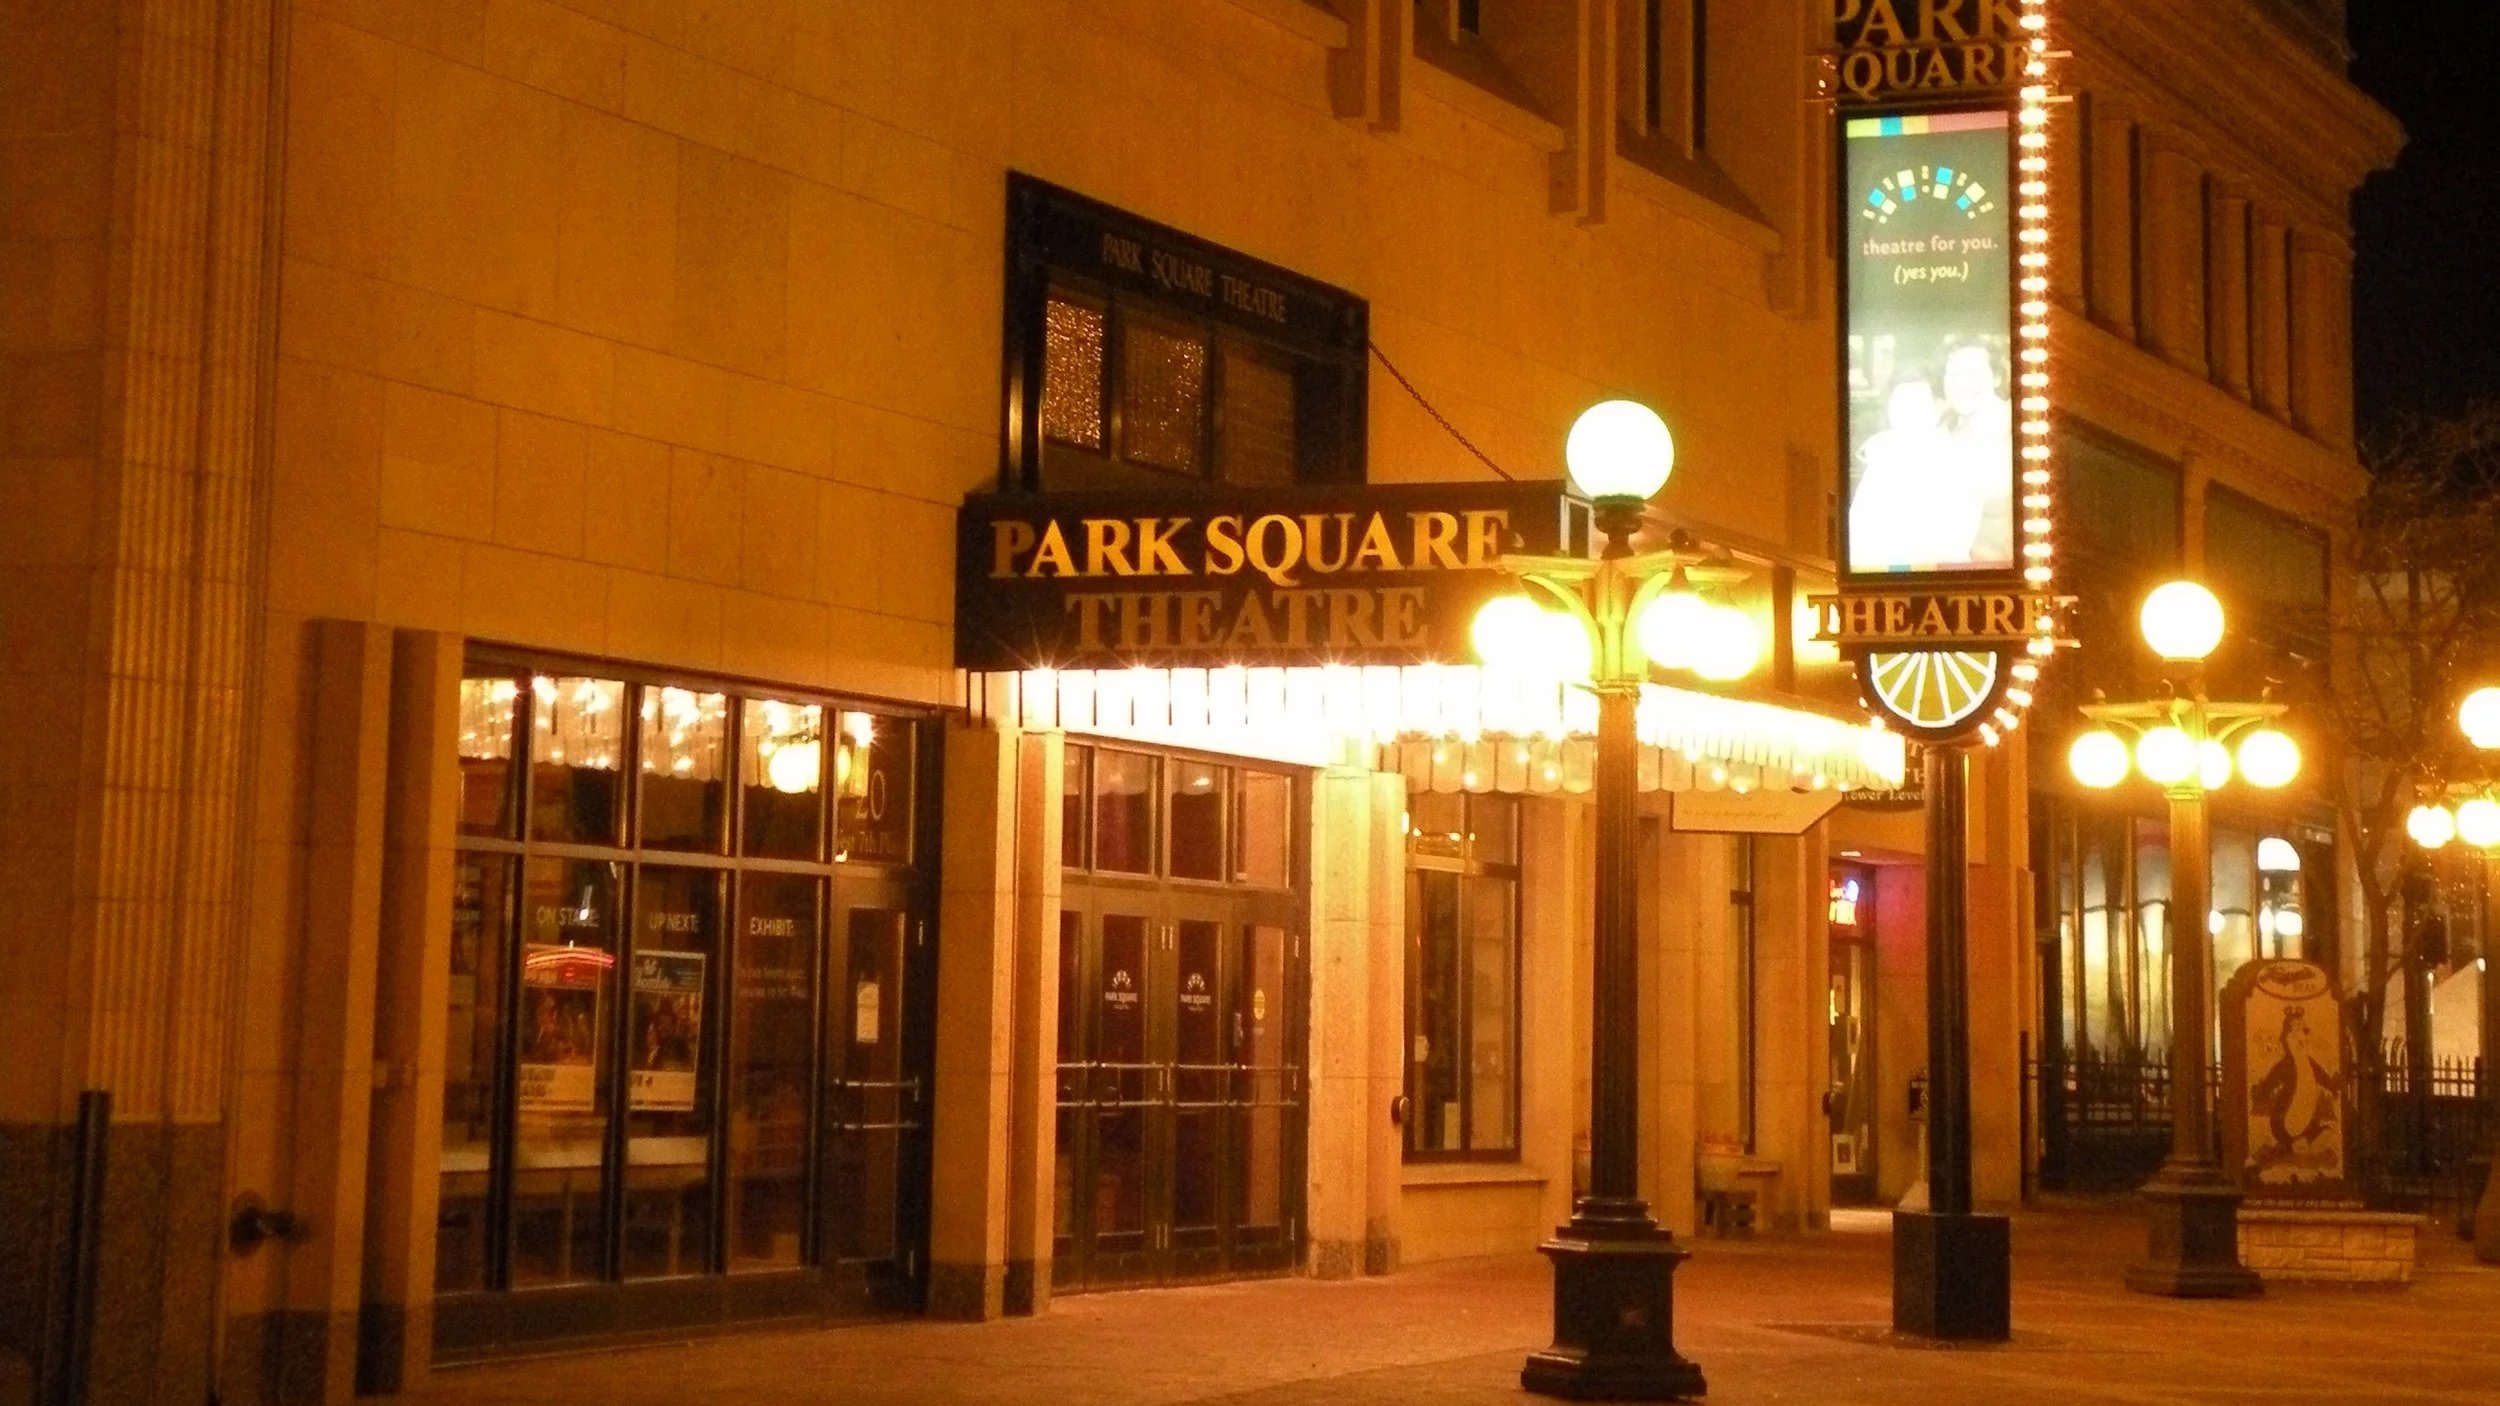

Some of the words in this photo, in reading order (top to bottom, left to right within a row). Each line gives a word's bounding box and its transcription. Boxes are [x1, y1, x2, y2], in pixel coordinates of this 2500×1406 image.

[1863, 238, 1925, 256] theatre
[1930, 235, 1956, 251] for
[1962, 236, 1999, 254] you.
[1103, 233, 1143, 273] PARK
[1151, 249, 1213, 297] SQUARE
[1220, 273, 1287, 322] THEATRE
[1894, 264, 1927, 285] (yes
[1929, 260, 1969, 284] you.)
[989, 517, 1193, 579] PARK
[1204, 509, 1509, 587] SQUARE
[1065, 586, 1429, 652] THEATRE
[1808, 595, 2050, 641] THEATRE
[536, 906, 557, 925] ON
[649, 912, 666, 930] UP
